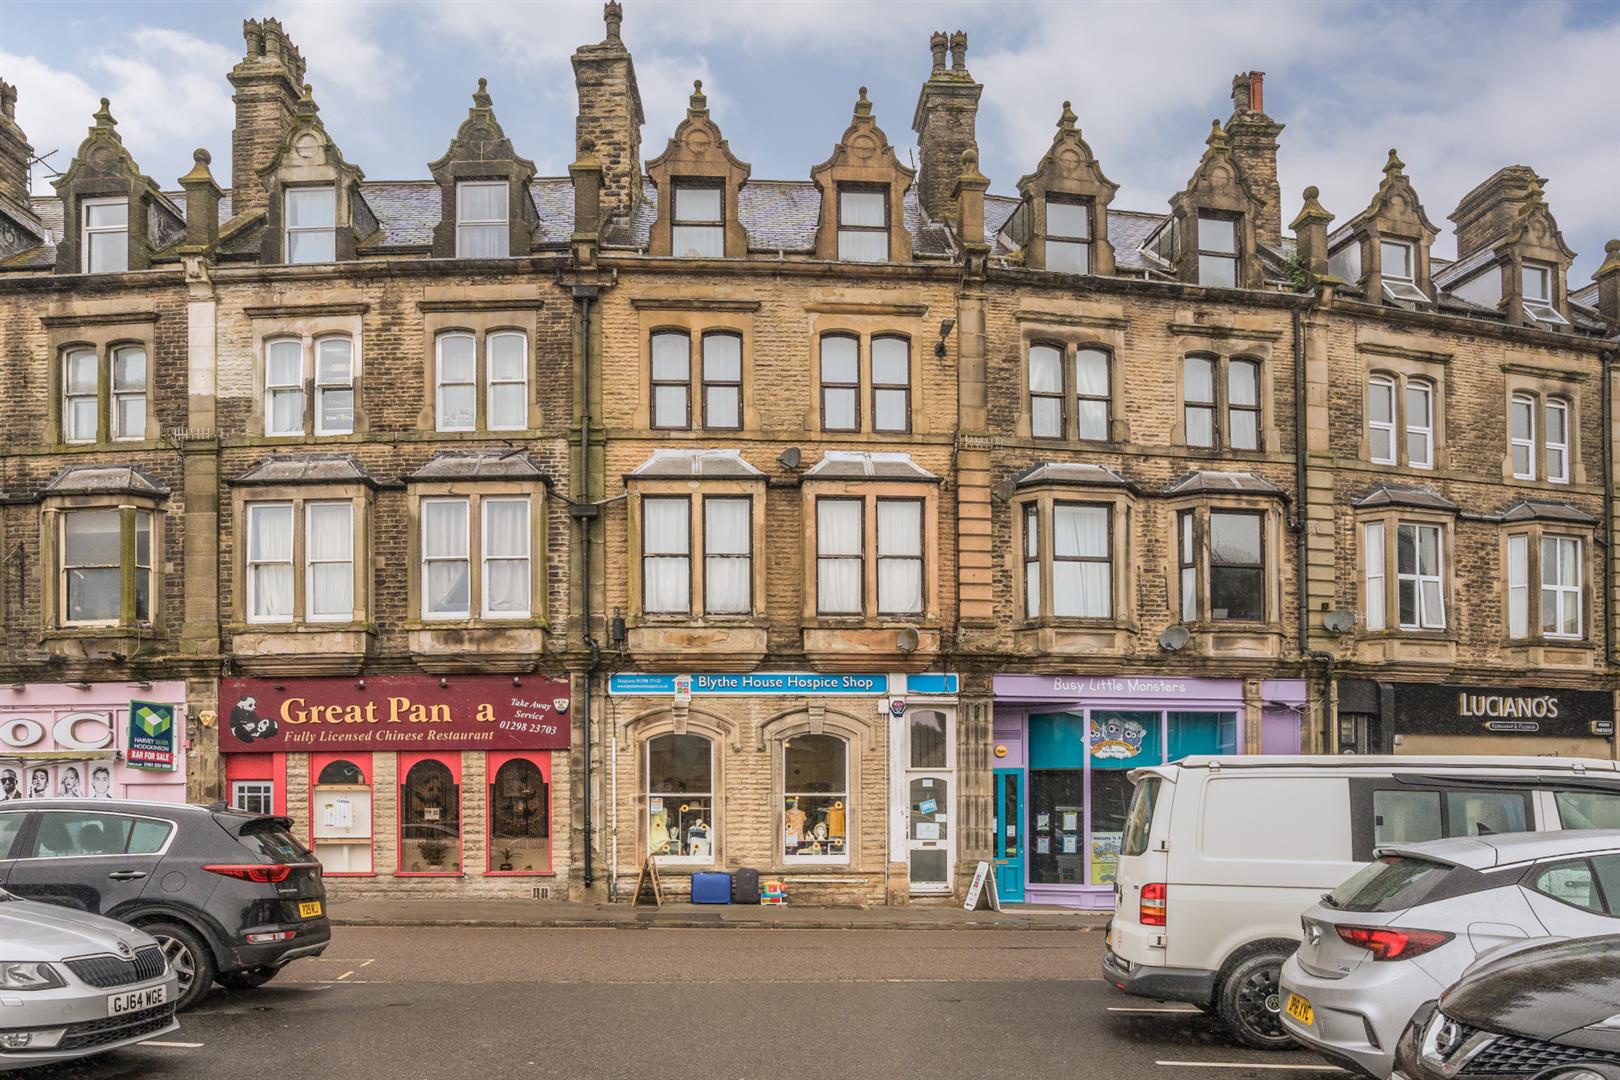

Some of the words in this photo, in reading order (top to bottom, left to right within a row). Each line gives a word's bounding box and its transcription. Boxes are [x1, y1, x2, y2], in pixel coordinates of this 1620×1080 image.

[698, 676, 738, 690] Blythe
[742, 677, 783, 688] House
[787, 677, 838, 690] Hospice
[842, 677, 873, 690] Shop
[1054, 677, 1085, 693] Busy
[1089, 678, 1123, 692] Little
[1127, 679, 1186, 693] Monsters
[280, 697, 379, 724] Great
[511, 698, 529, 708] Take
[529, 701, 552, 712] Away
[514, 710, 545, 720] Service
[499, 720, 528, 732] 01298
[528, 723, 557, 735] 23703
[284, 730, 316, 744] Fully
[319, 730, 372, 742] Licensed
[376, 730, 424, 741] Chinese
[427, 729, 495, 741] Restaurant
[133, 743, 170, 751] HODGKINSON
[131, 750, 144, 759] BAR
[144, 751, 156, 760] FOR
[156, 752, 170, 762] SALE
[114, 993, 144, 1013] GJ64
[145, 988, 163, 1007] WGE
